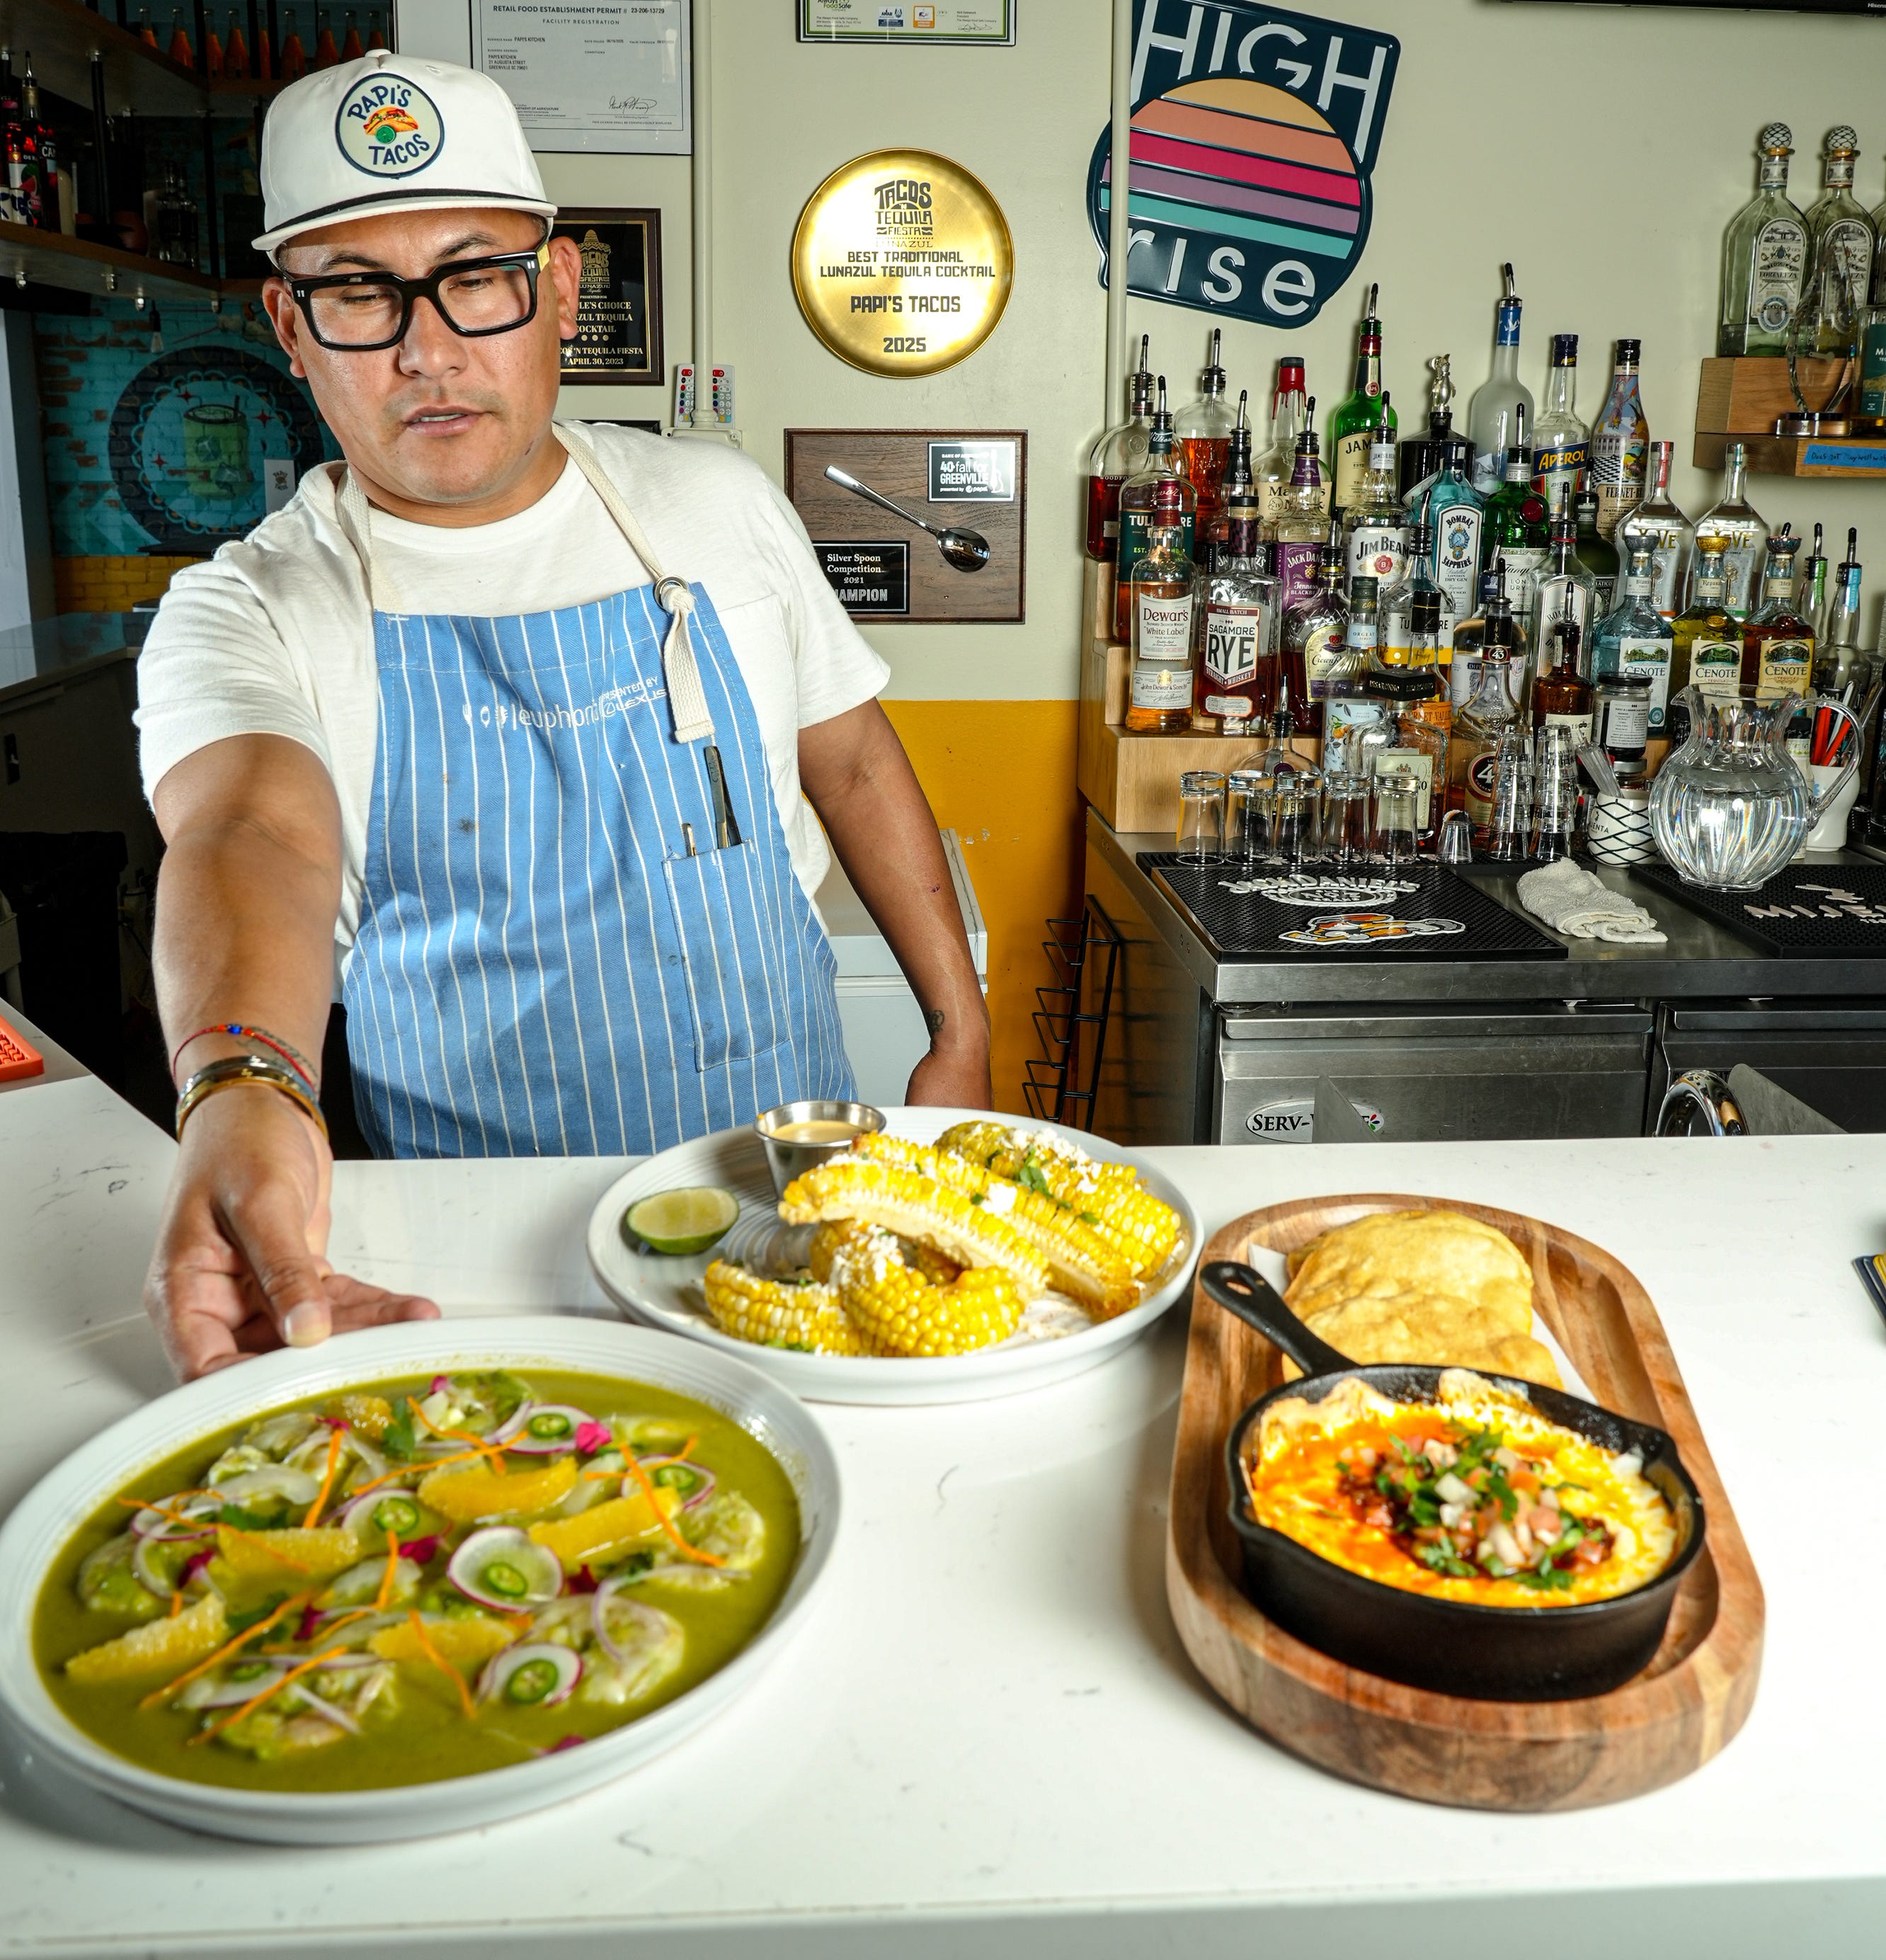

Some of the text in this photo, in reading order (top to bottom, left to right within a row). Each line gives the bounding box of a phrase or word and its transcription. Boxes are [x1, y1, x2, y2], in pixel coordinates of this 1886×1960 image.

[1130, 0, 1388, 164] HIGH
[347, 84, 411, 120] PAPI'S
[368, 133, 430, 165] TACOS
[874, 179, 932, 210] TACOS
[875, 210, 933, 225] TEQUILA
[888, 227, 921, 236] FIESTA
[582, 251, 610, 268] ACOS
[848, 251, 964, 263] BEST TRADITIONAL
[821, 266, 995, 278] LUNAZUL TEQUILA COCKTAIL
[1127, 227, 1315, 317] rise
[851, 295, 961, 313] PAPI'S TACOS
[595, 314, 633, 322] TEQUILA
[582, 347, 615, 355] TEQUILA
[883, 337, 927, 353] 2025
[593, 358, 605, 366] 30,
[955, 461, 971, 473] fall
[1538, 450, 1586, 471] APEROL
[940, 472, 989, 484] GREENVILLE
[1446, 515, 1475, 529] BOMBAY
[1356, 536, 1410, 560] JIM BEAM
[827, 554, 881, 564] Silver Spoon
[1286, 553, 1305, 568] JACK
[1441, 557, 1473, 569] SAPPHIRE
[827, 564, 881, 575] Competition
[1293, 581, 1318, 591] Tenness
[1143, 608, 1189, 622] Dewar's
[1208, 624, 1255, 635] SAGAMORE
[1207, 633, 1255, 675] RYE
[1312, 655, 1333, 666] Crown
[1492, 650, 1504, 660] 43
[1206, 668, 1252, 685] STRAIGHT WHISKEY
[1625, 666, 1667, 676] CENOTE
[1696, 667, 1737, 678] CENOTE
[1765, 665, 1807, 676] CENOTE
[646, 676, 658, 688] BY
[1369, 680, 1400, 693] DISARONNO
[519, 688, 668, 730] euphori LEXUS
[1218, 874, 1421, 894] JACK DANIEL'S
[1744, 905, 1886, 919] MIJE
